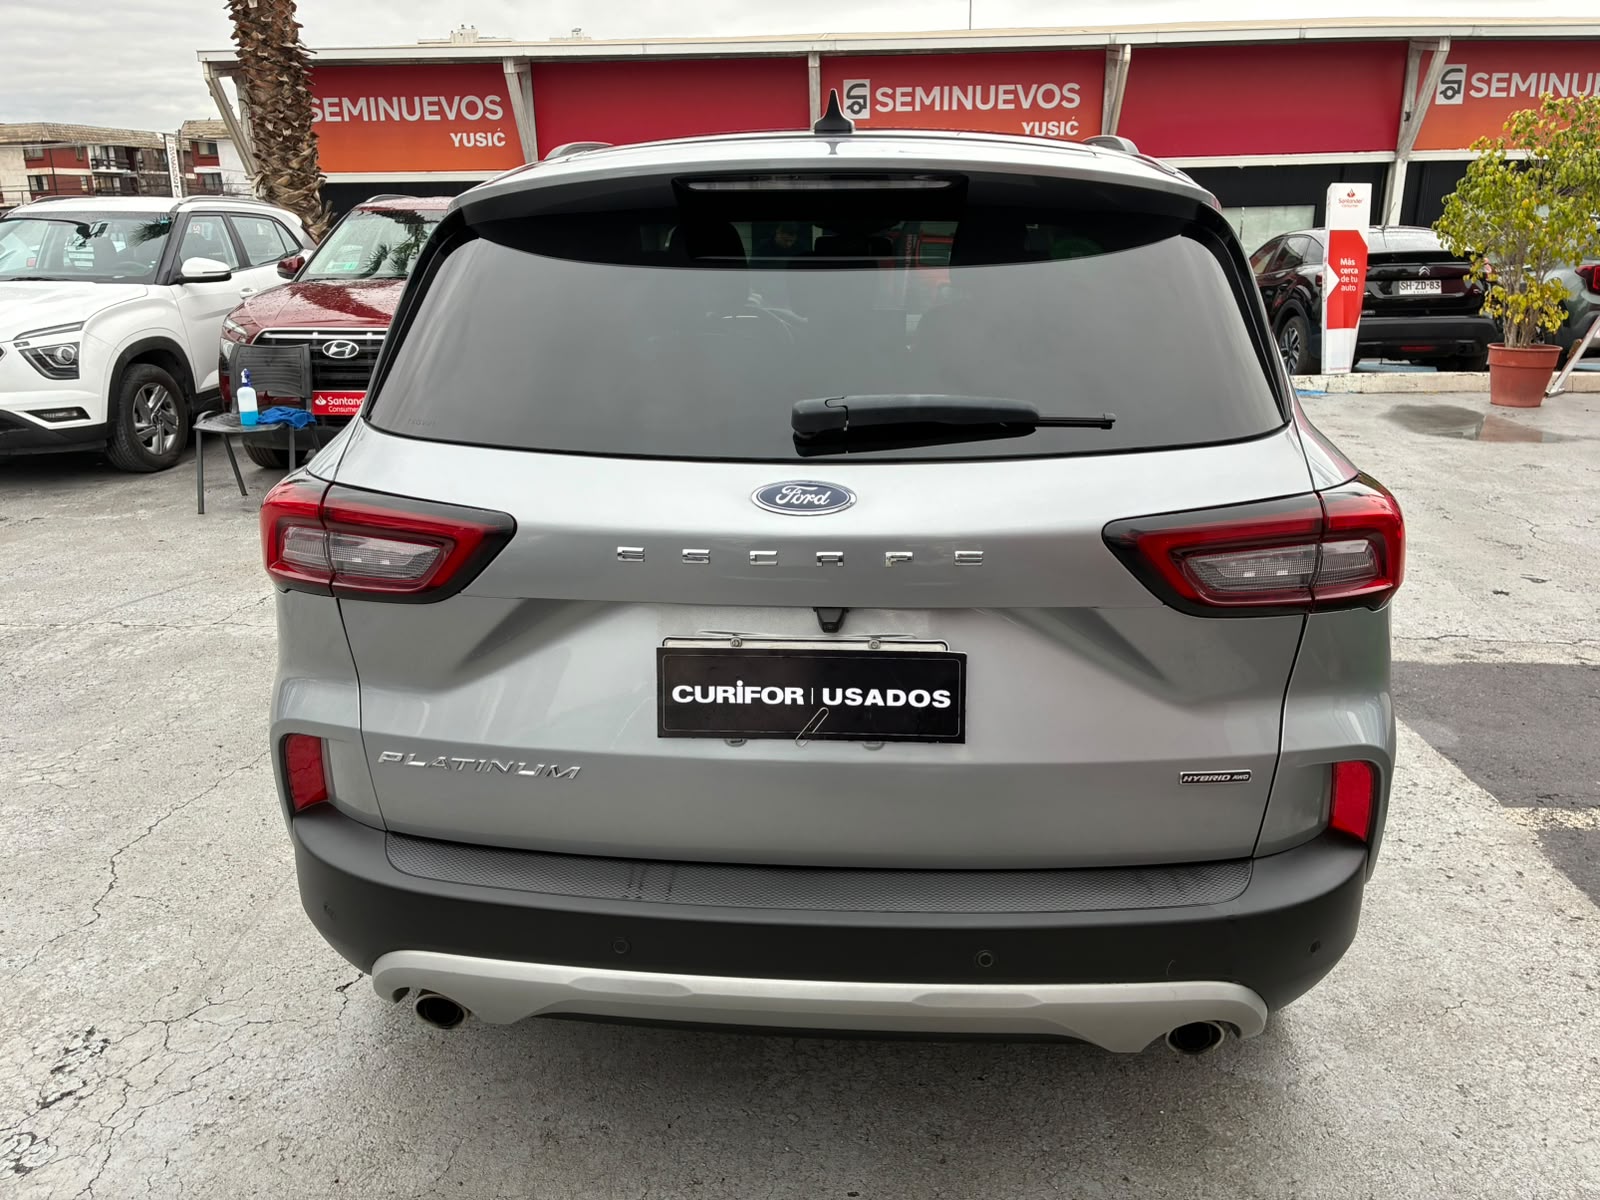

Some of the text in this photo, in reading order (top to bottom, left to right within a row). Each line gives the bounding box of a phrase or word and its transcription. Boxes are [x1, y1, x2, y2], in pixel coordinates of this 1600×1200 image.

[311, 95, 504, 122] SEMINUEVOS
[875, 82, 1081, 113] SEMINUEVOS
[1021, 116, 1079, 136] YUSIĆ
[450, 128, 506, 148] YUSIĆ
[1340, 257, 1355, 265] Más
[775, 484, 831, 506] Ford
[616, 546, 984, 568] ESCAPE
[822, 688, 951, 708] USADOS
[378, 750, 581, 780] PLATINUM
